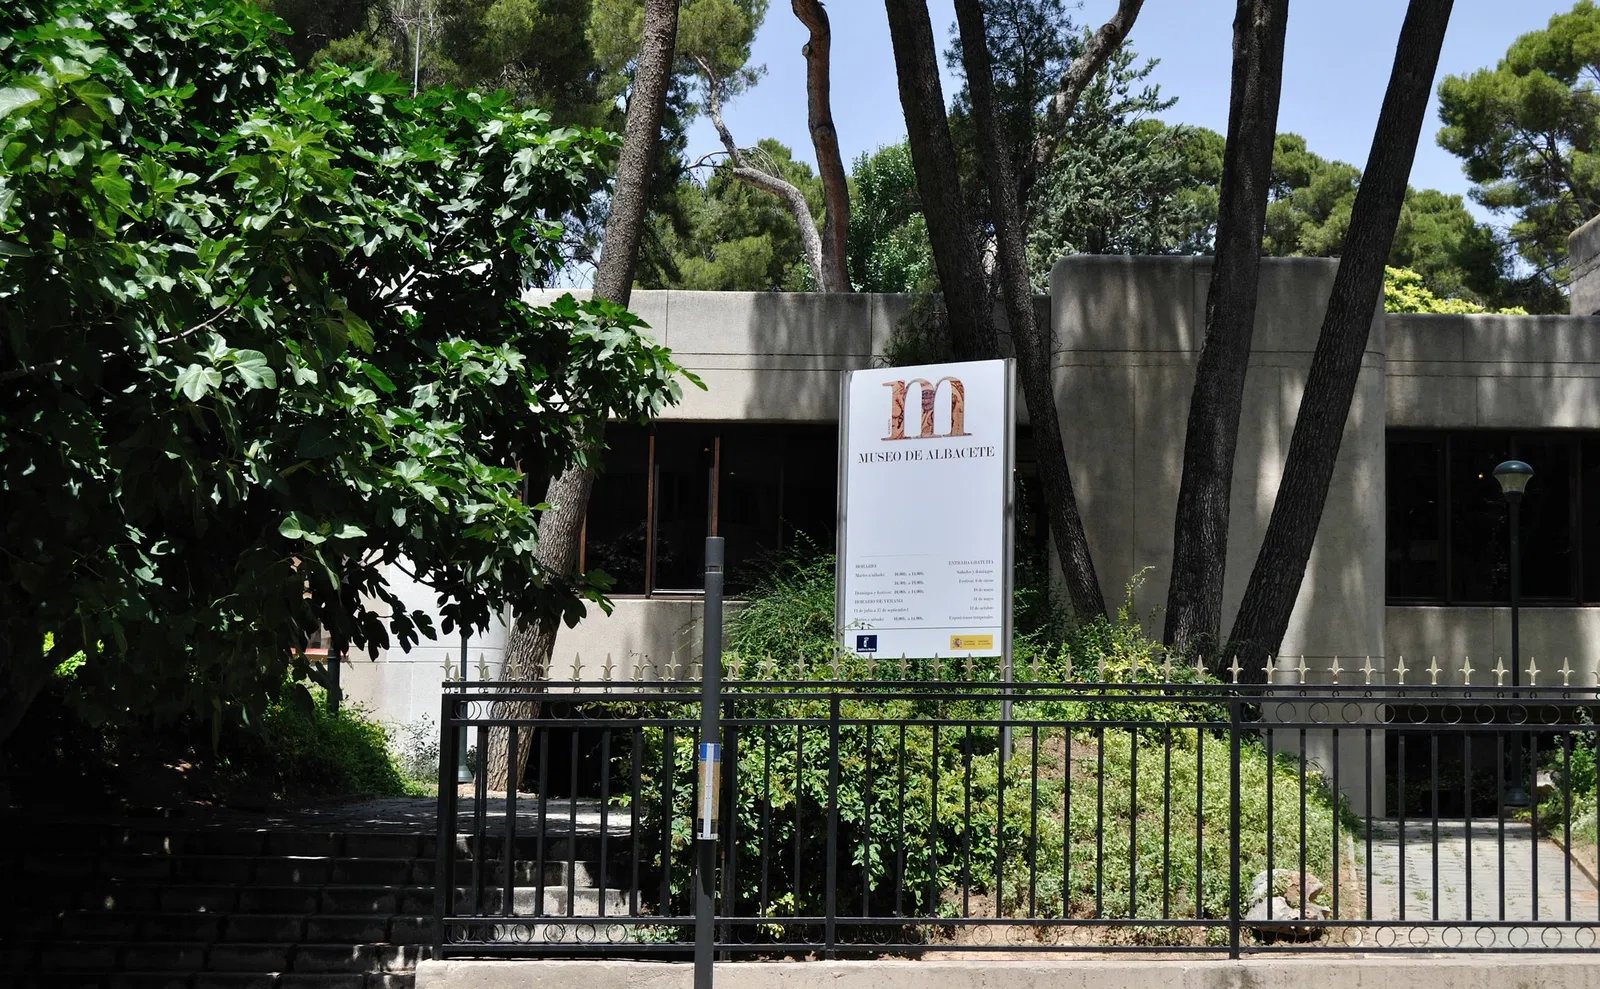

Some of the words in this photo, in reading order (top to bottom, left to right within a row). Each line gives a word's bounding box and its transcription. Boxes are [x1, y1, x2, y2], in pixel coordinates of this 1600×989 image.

[881, 376, 972, 440] m
[859, 451, 902, 463] MUSEO
[905, 450, 923, 461] DE
[926, 446, 995, 460] ALBACETE
